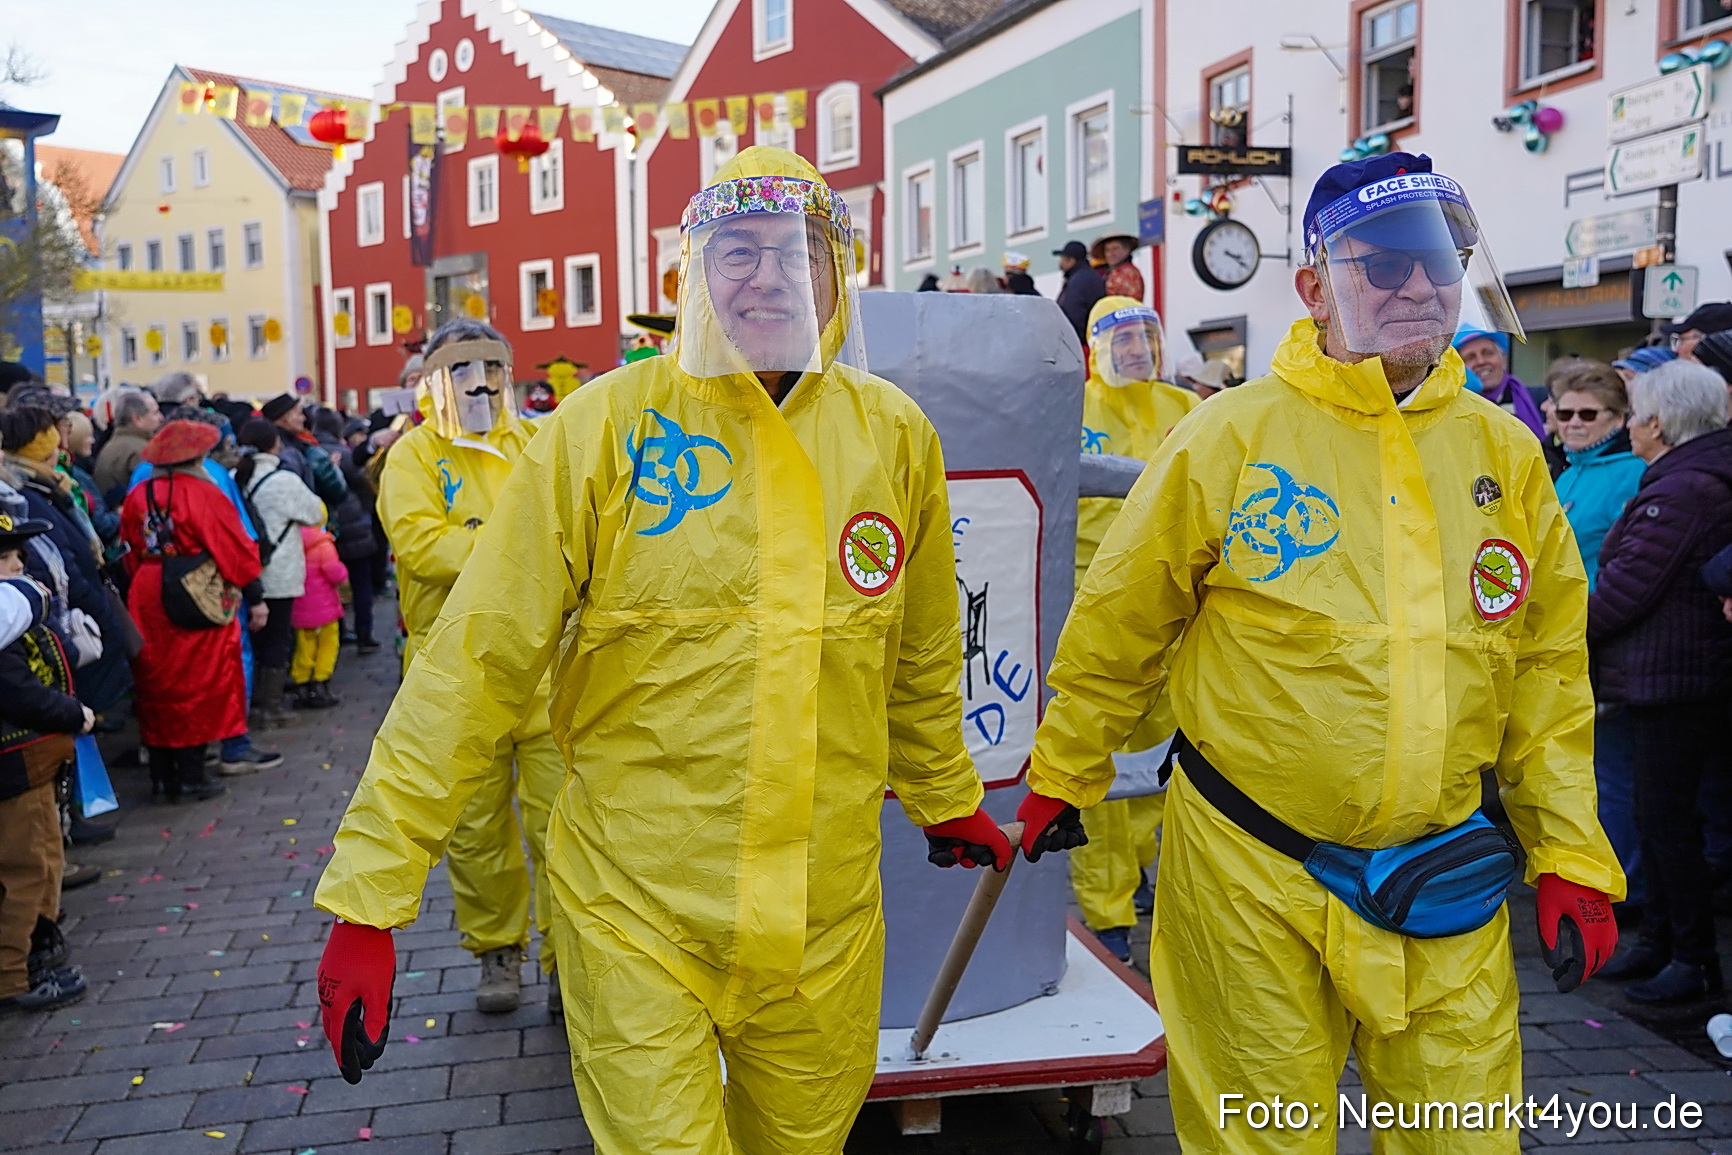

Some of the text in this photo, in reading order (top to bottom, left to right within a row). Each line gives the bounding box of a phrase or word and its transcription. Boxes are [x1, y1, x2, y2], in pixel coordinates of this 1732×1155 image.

[1366, 176, 1456, 199] FACE SHIELD
[1365, 196, 1397, 212] SPLASH
[1397, 191, 1444, 202] PROTECTION
